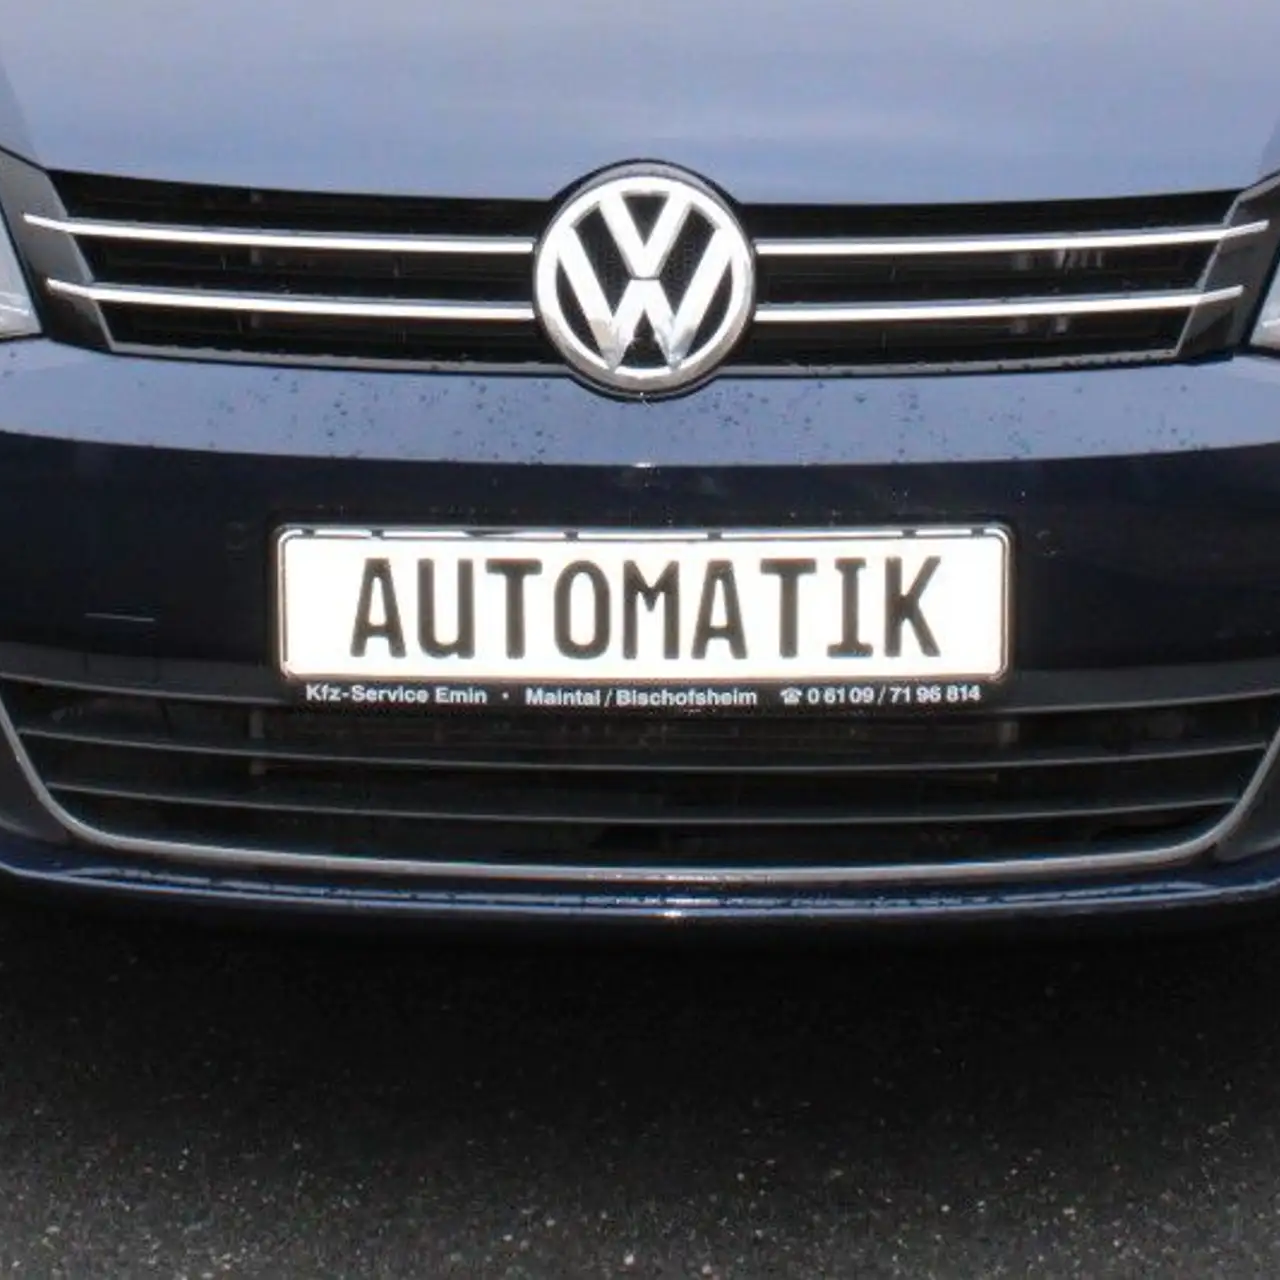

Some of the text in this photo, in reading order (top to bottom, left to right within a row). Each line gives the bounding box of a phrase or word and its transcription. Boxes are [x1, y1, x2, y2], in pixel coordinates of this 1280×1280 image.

[535, 165, 755, 392] VW
[349, 556, 942, 660] AUTOMATIK
[305, 683, 430, 703] Kfz-Service
[434, 686, 488, 704] Emin
[525, 687, 600, 706] Maintal
